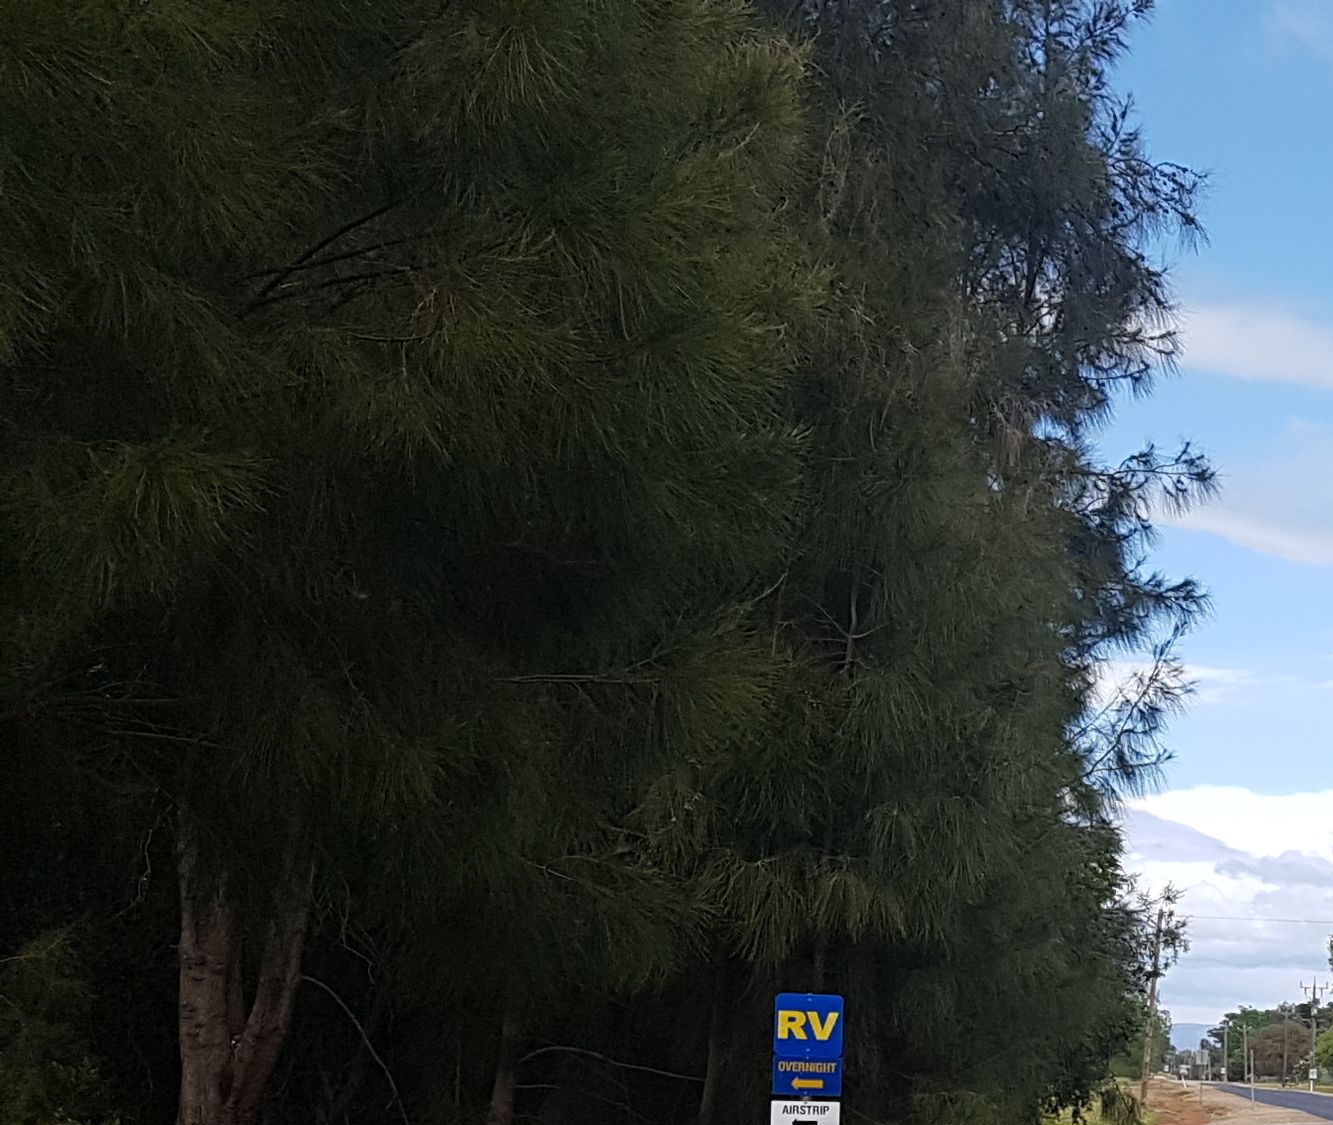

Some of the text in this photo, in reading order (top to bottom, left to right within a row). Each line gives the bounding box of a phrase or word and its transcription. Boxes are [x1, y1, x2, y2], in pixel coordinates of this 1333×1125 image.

[777, 1010, 839, 1041] RV
[778, 1061, 837, 1073] OVERNIGHT
[782, 1105, 829, 1115] AIRSTRIP
